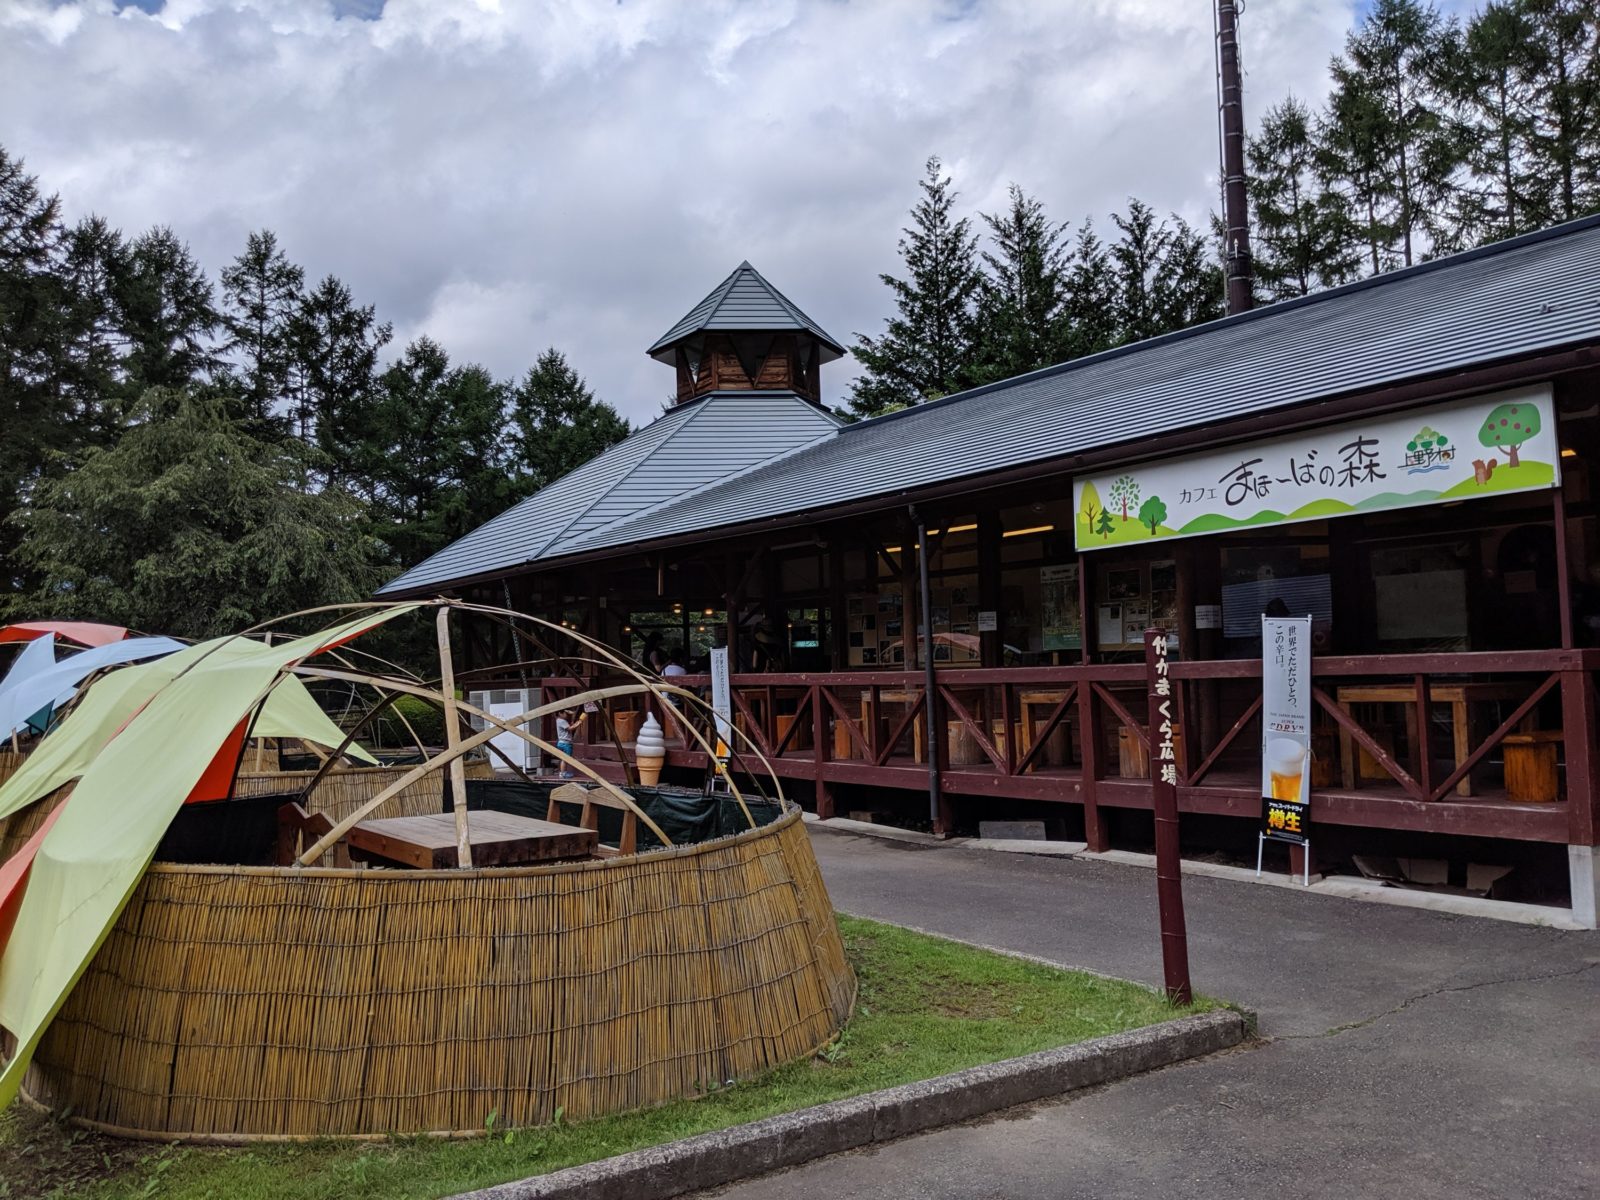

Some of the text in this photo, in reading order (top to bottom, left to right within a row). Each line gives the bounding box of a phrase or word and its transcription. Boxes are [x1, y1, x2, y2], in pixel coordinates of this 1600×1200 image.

[1397, 444, 1456, 469] 上野村
[1179, 486, 1217, 504] カフェ
[1152, 635, 1177, 787] 竹かまくら広場
[1268, 808, 1302, 833] 樽生
